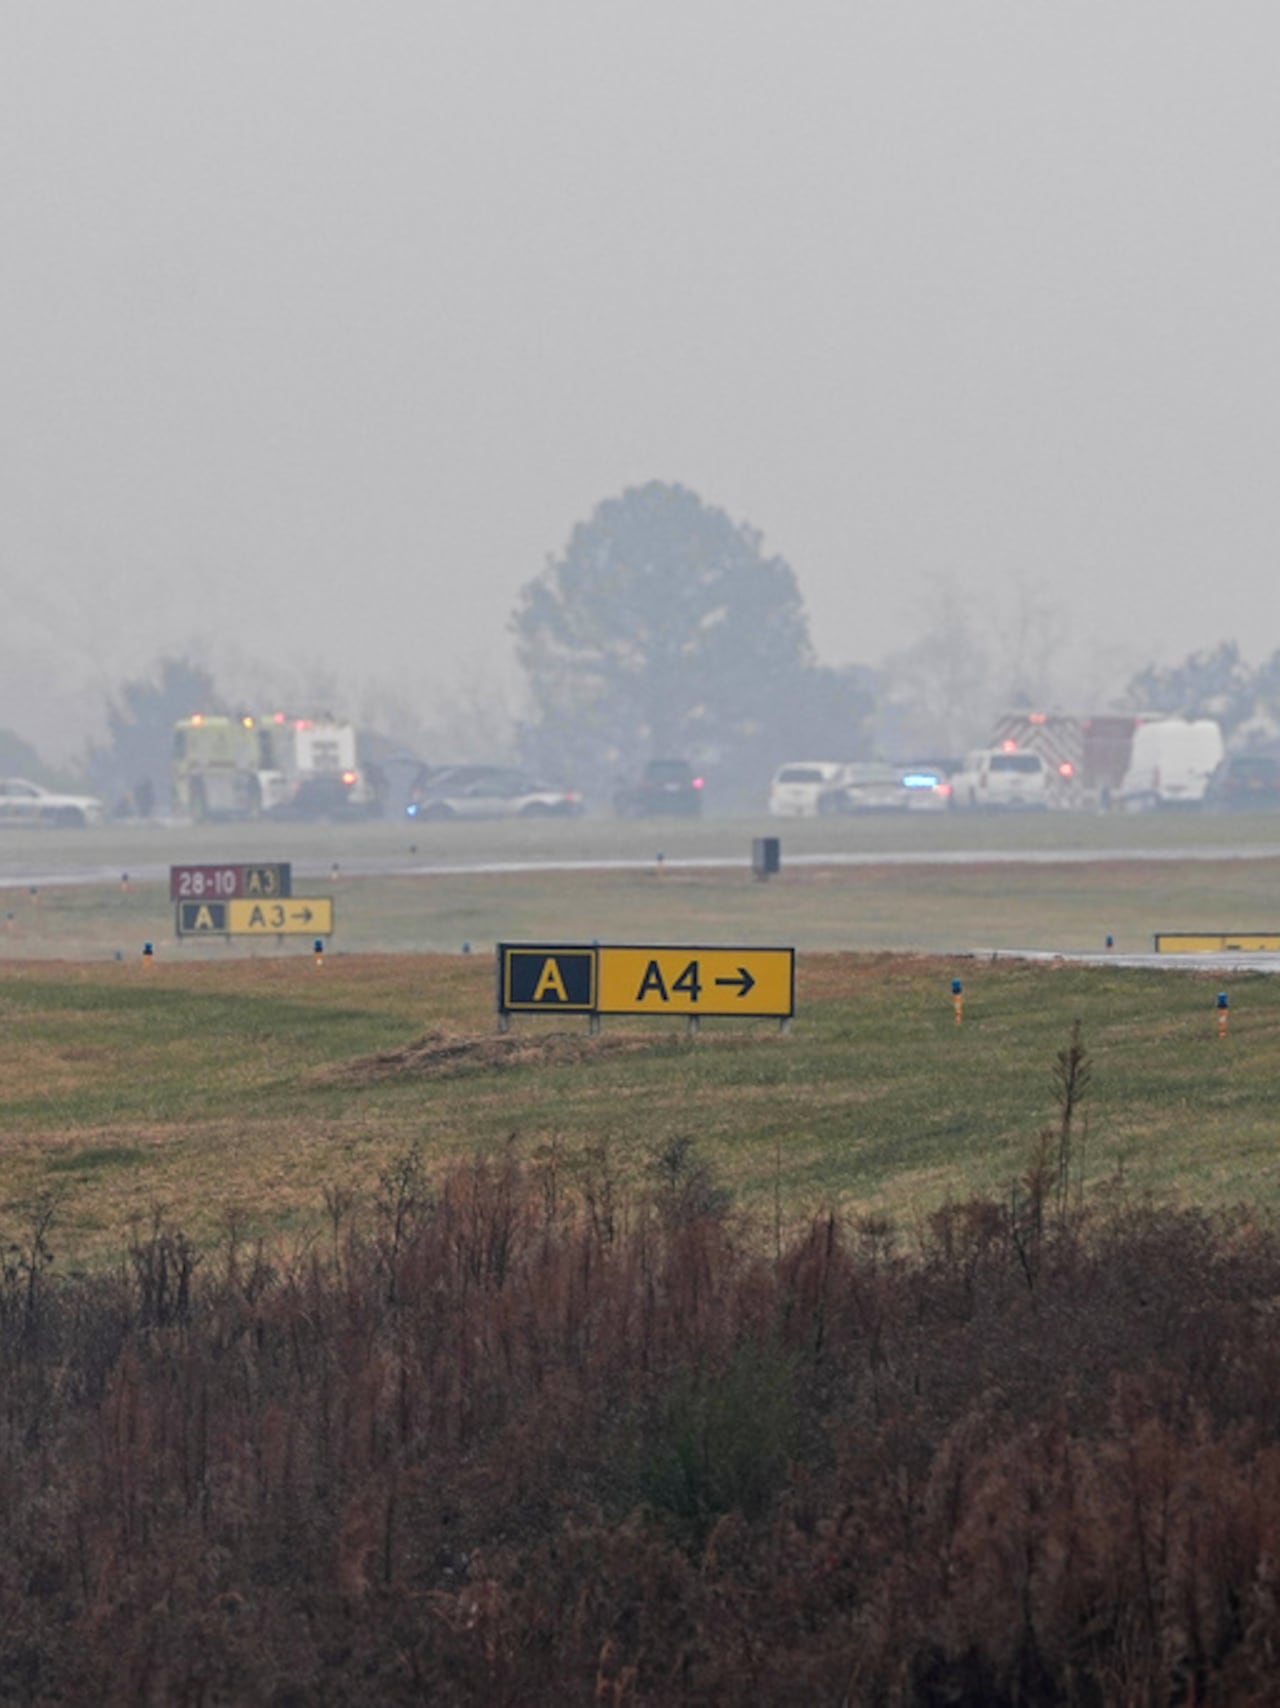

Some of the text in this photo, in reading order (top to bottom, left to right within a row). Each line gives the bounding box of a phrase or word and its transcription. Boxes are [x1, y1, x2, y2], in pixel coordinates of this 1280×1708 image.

[179, 869, 277, 895] 28-10 A3
[194, 904, 286, 929] A A3
[533, 957, 702, 1002] A A4
